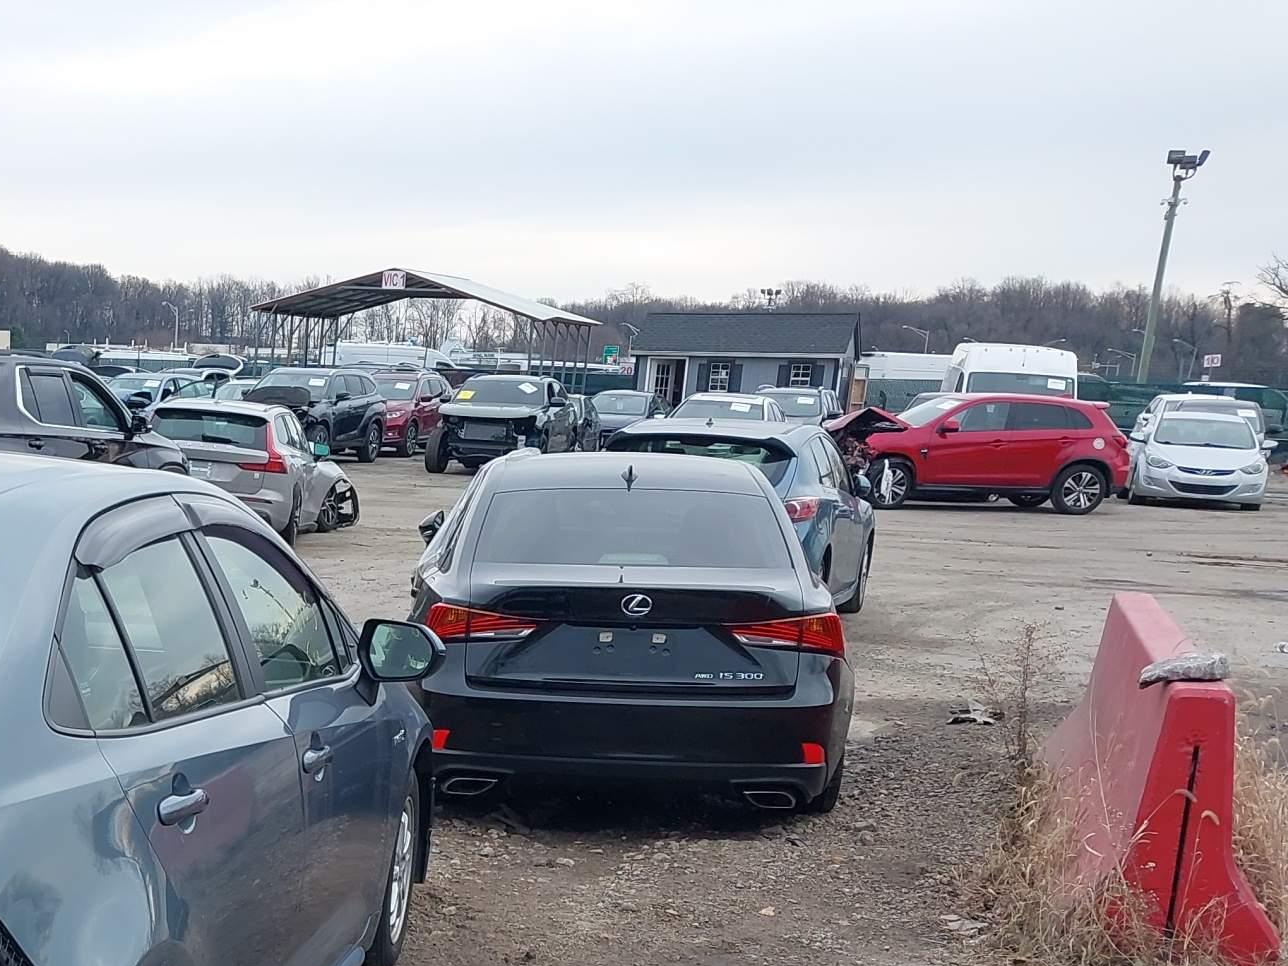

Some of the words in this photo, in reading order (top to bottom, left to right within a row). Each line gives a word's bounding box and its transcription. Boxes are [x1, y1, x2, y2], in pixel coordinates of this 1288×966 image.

[383, 272, 399, 287] VIC
[621, 366, 633, 375] 20
[719, 672, 734, 680] IS
[735, 672, 764, 680] 300
